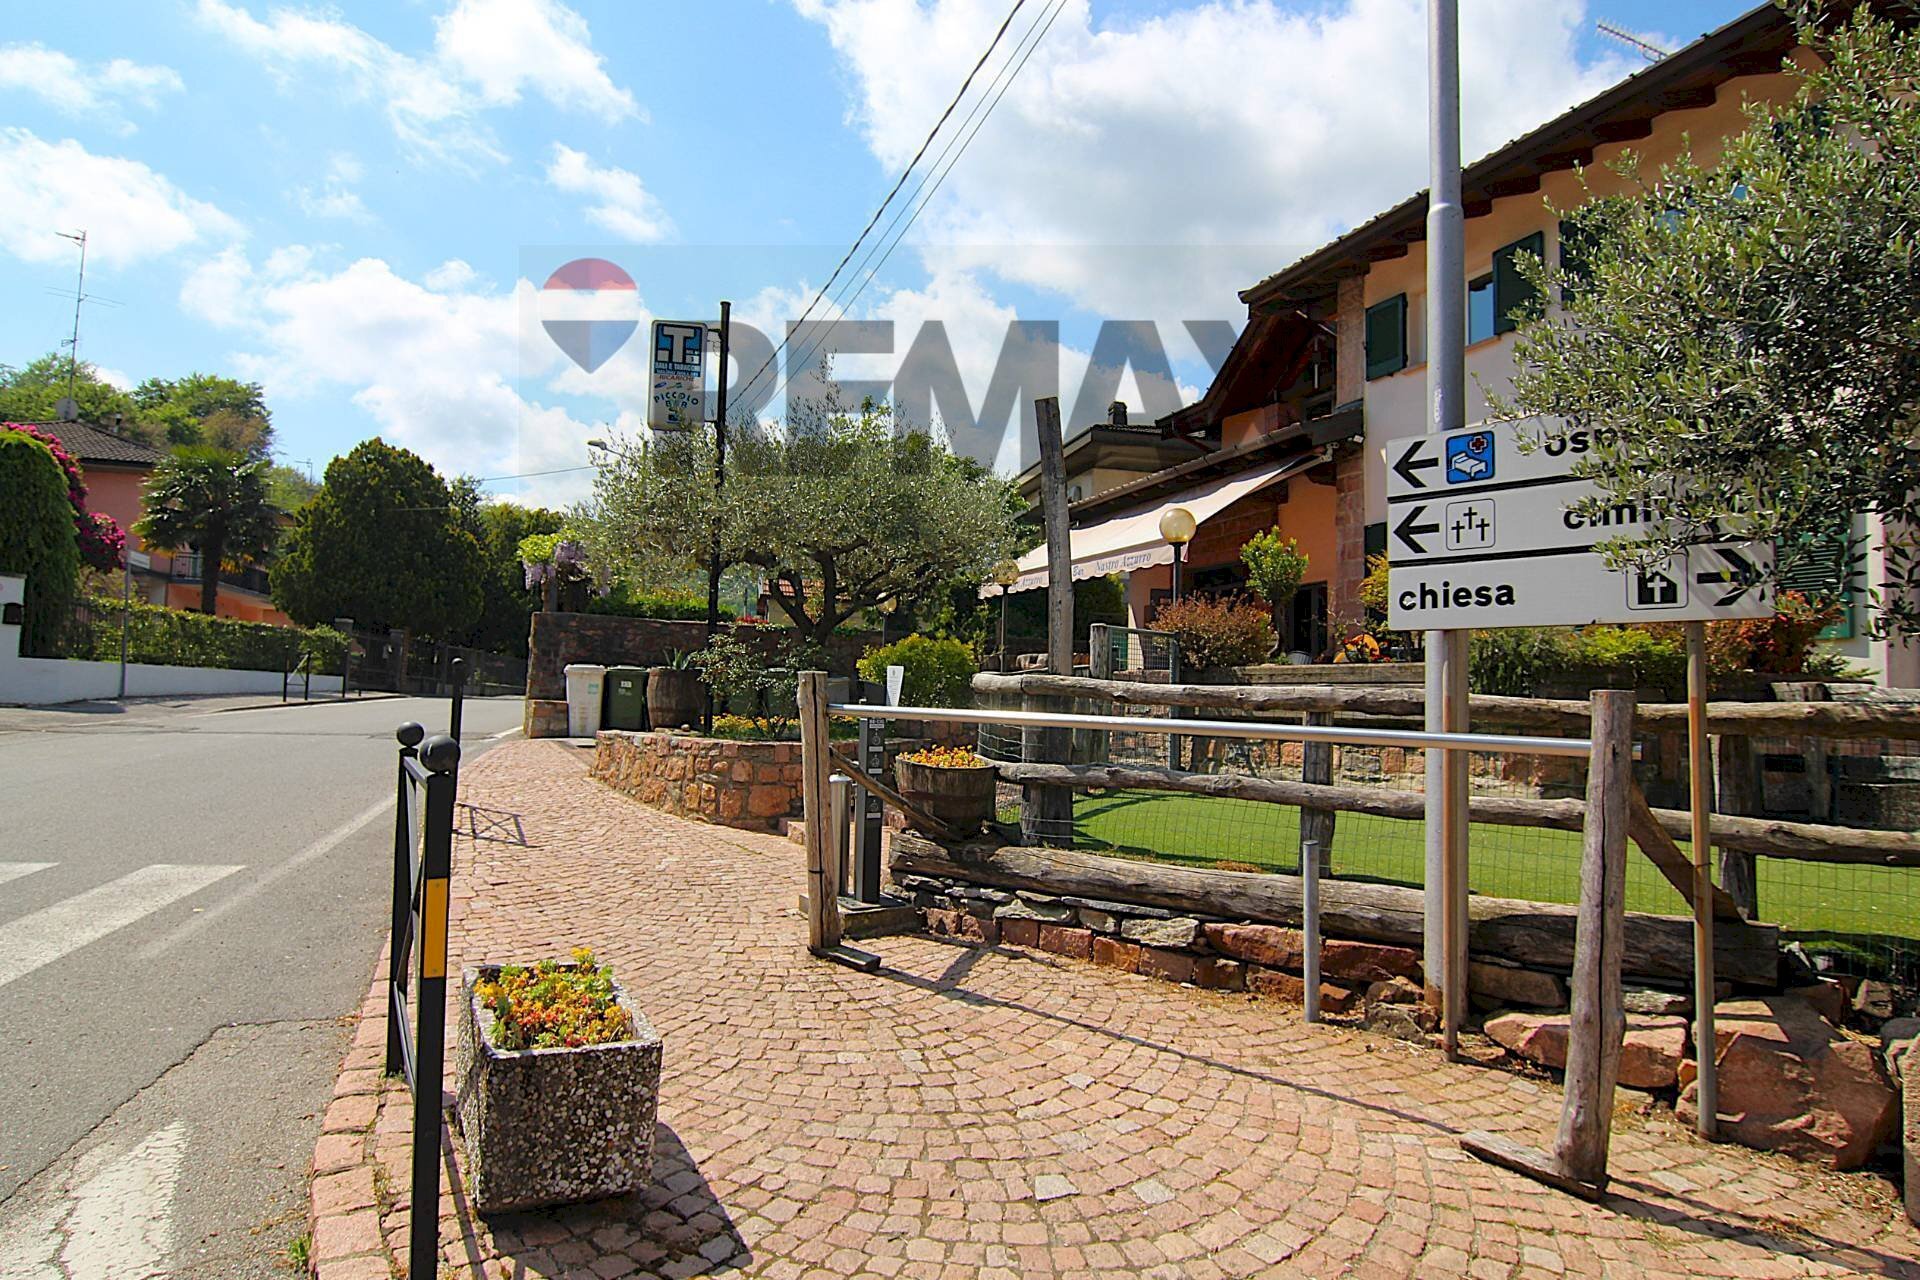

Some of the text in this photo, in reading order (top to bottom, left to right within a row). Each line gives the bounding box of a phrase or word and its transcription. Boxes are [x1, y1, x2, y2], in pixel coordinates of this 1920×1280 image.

[653, 391, 699, 406] PICCOLO
[1095, 559, 1119, 573] Nastro
[1120, 552, 1152, 568] Azzurro
[1398, 580, 1516, 611] chiesa
